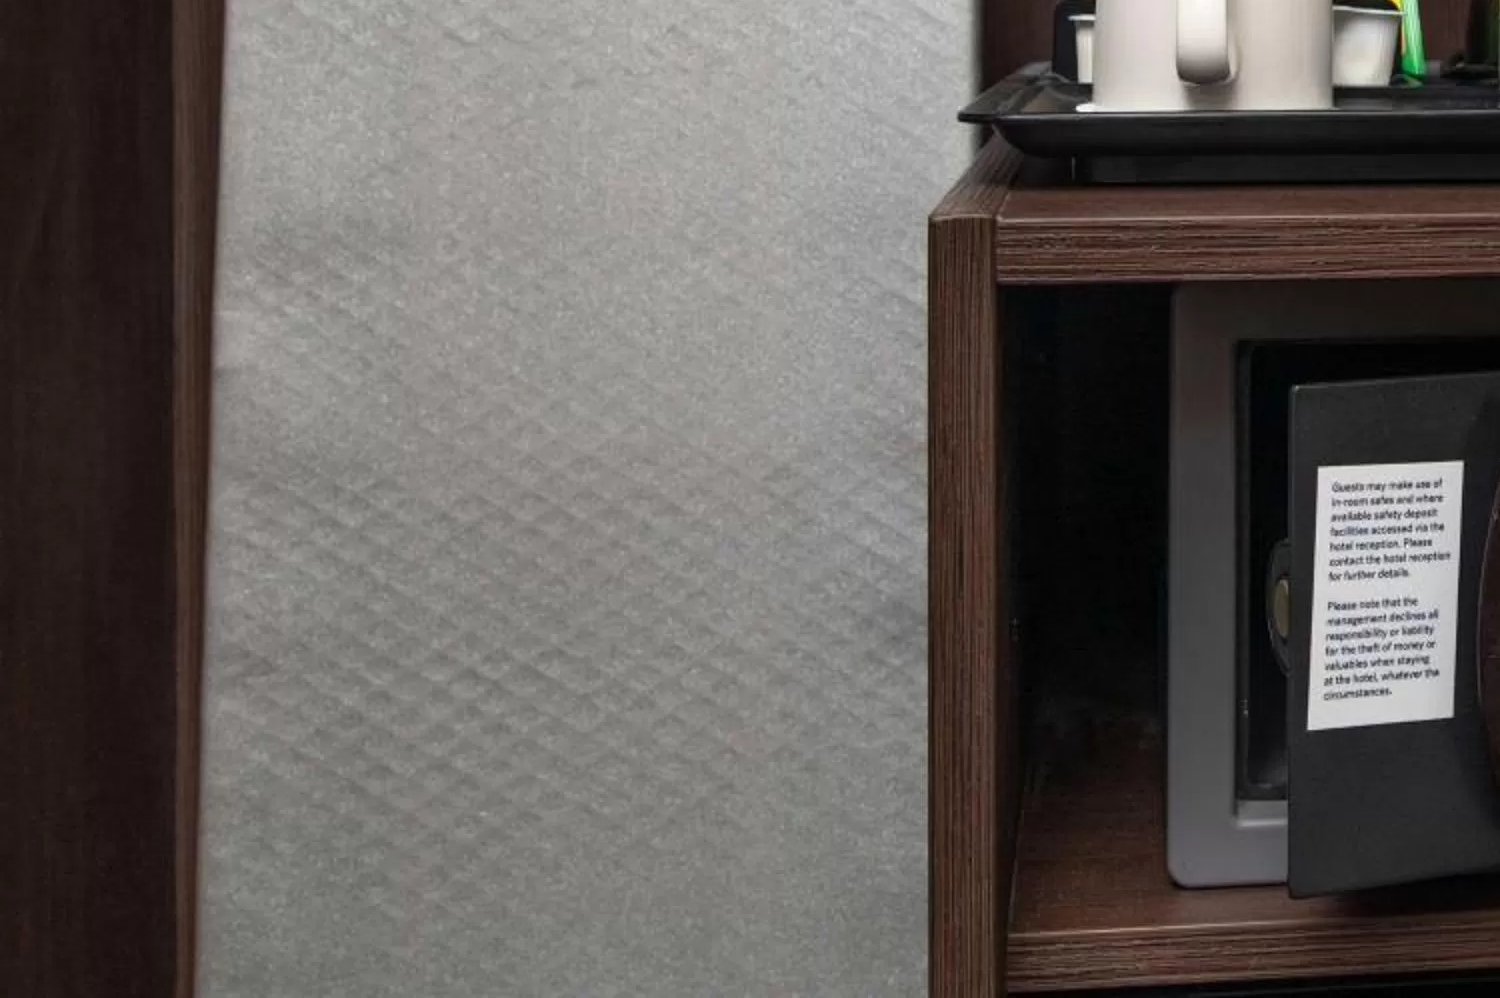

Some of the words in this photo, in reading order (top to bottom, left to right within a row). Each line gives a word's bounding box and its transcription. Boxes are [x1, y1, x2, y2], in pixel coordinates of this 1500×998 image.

[1332, 482, 1364, 493] Guests
[1366, 482, 1385, 494] may
[1388, 481, 1412, 489] make
[1416, 481, 1430, 489] use
[1433, 478, 1443, 488] of
[1331, 498, 1368, 507] in-room
[1370, 496, 1393, 505] safes
[1396, 495, 1414, 504] and
[1416, 494, 1443, 503] where
[1331, 512, 1371, 522] available
[1374, 510, 1401, 521] safety
[1403, 509, 1438, 521] deposit
[1330, 527, 1369, 537] facilities
[1371, 524, 1413, 535] accessed
[1415, 524, 1428, 532] via
[1430, 522, 1445, 531] the
[1329, 542, 1353, 552] hotel
[1355, 540, 1399, 552] reception.
[1403, 538, 1433, 548] Please
[1329, 556, 1364, 567] contact
[1366, 555, 1381, 565] the
[1383, 553, 1407, 563] hotel
[1408, 552, 1451, 564] reception
[1328, 572, 1341, 581] for
[1343, 570, 1376, 580] further
[1378, 567, 1409, 577] details.
[1327, 601, 1356, 611] Please
[1359, 601, 1379, 610] note
[1381, 598, 1401, 607] that
[1403, 597, 1418, 606] the
[1326, 615, 1387, 627] management
[1389, 612, 1426, 621] declines
[1428, 609, 1438, 619] all
[1390, 628, 1399, 636] or
[1401, 625, 1434, 637] liability
[1325, 646, 1339, 656] for
[1341, 645, 1356, 655] the
[1358, 643, 1380, 653] theft
[1382, 642, 1392, 651] of
[1393, 641, 1424, 652] money
[1426, 640, 1436, 649] or
[1324, 659, 1368, 671] valuables
[1370, 657, 1394, 667] when
[1398, 655, 1430, 667] staying
[1323, 676, 1333, 686] at
[1335, 674, 1350, 684] the
[1353, 672, 1378, 683] hotel,
[1381, 671, 1422, 681] whatever
[1425, 669, 1440, 678] the
